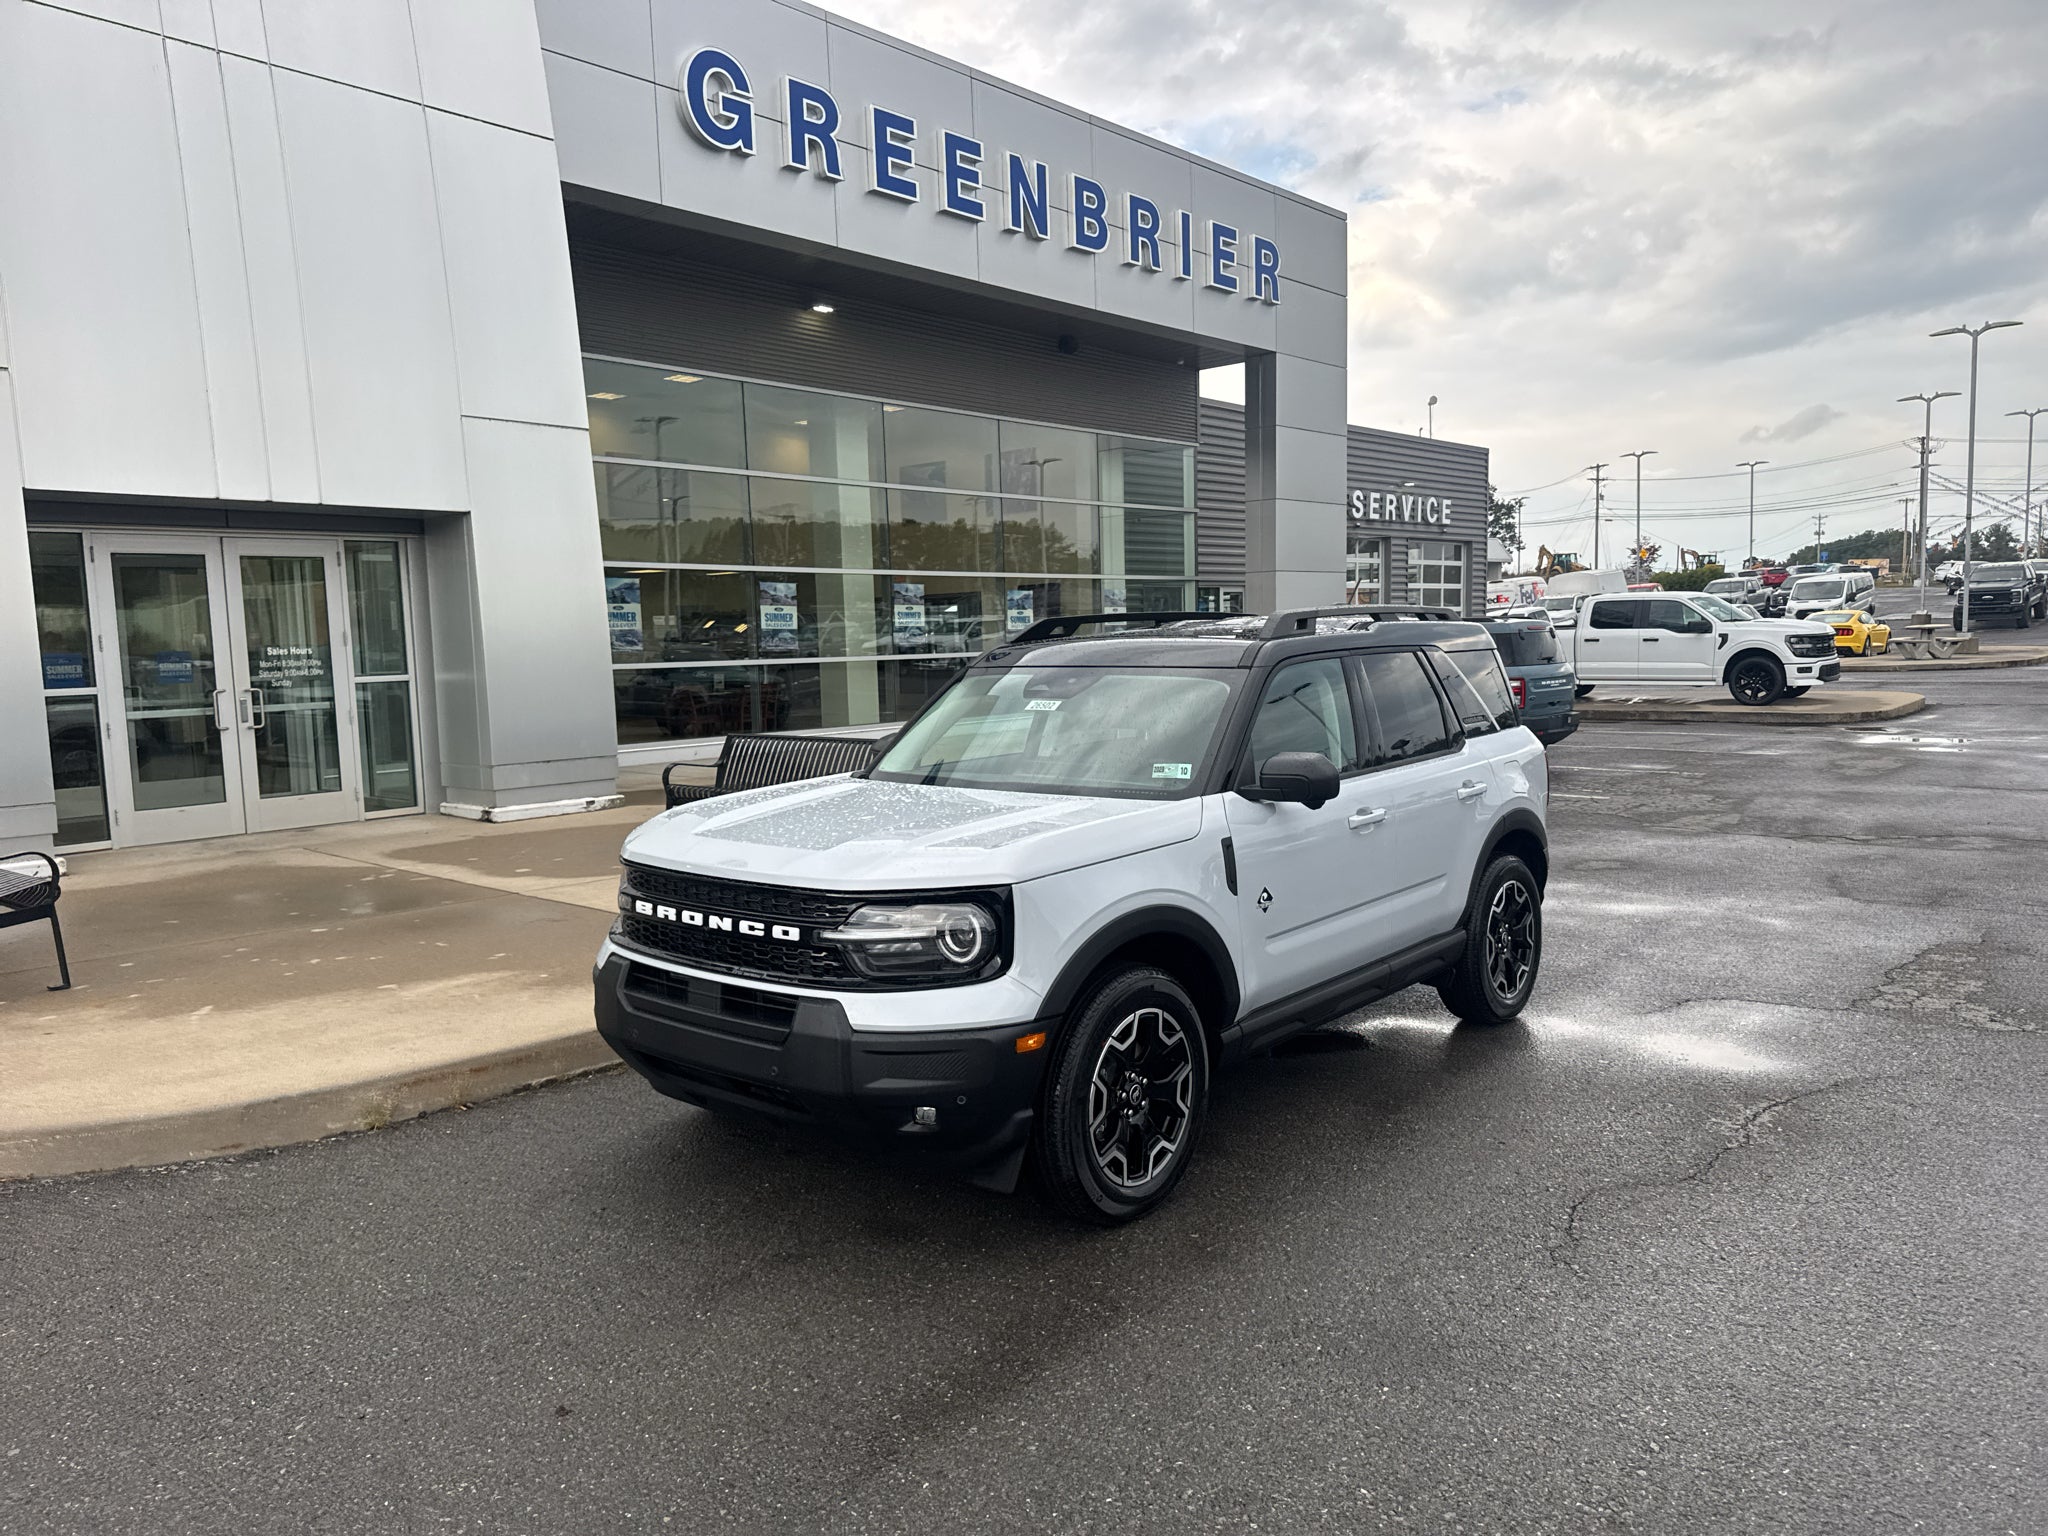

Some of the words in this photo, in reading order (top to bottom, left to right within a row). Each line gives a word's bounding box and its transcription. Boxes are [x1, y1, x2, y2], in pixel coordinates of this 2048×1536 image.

[678, 46, 1281, 304] GREENBRIER
[1352, 490, 1452, 524] SERVICE
[1487, 594, 1510, 605] edEx
[608, 611, 637, 622] UMMER
[764, 612, 794, 623] SUMMER
[267, 647, 288, 655] Sales
[289, 646, 313, 655] Hours
[46, 664, 83, 674] SUMMER
[258, 669, 283, 679] Saturday
[271, 679, 293, 688] Sunday
[1180, 766, 1189, 776] 10
[635, 899, 801, 942] BRONCO
